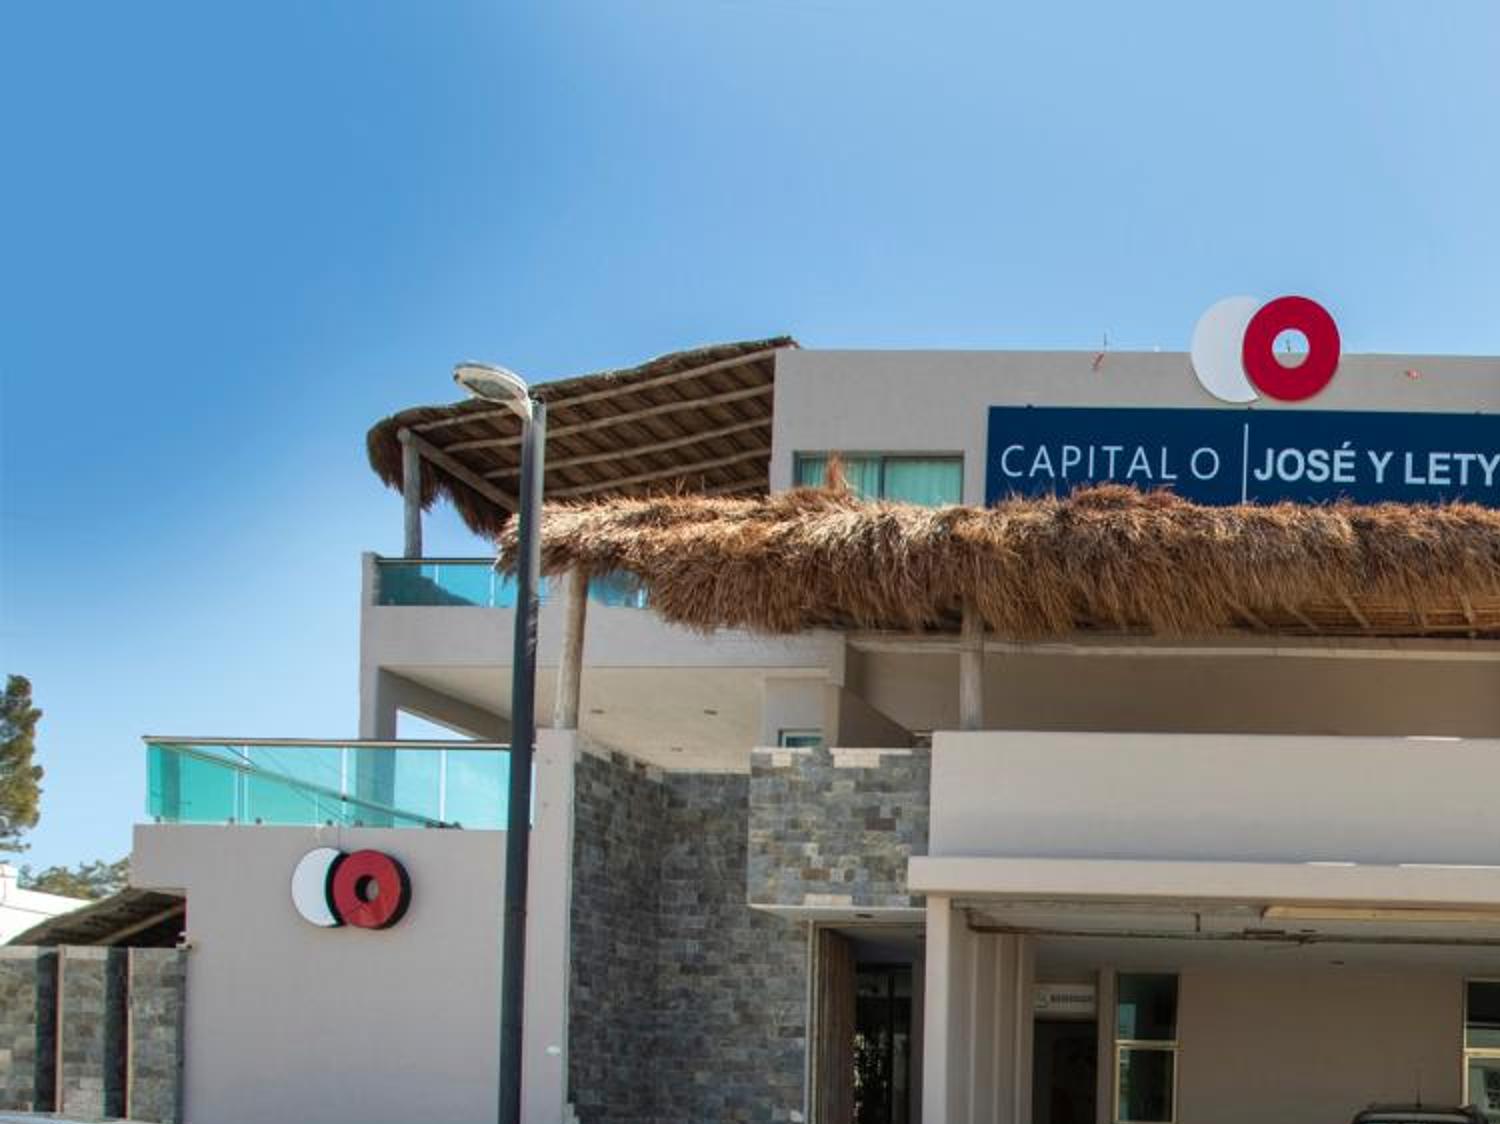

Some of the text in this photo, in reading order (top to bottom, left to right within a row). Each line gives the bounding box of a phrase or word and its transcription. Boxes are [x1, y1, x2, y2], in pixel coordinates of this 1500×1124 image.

[1000, 444, 1178, 480] CAPITAL
[1190, 447, 1220, 480] O
[1253, 441, 1356, 483] JOSÉ
[1367, 451, 1394, 484] Y
